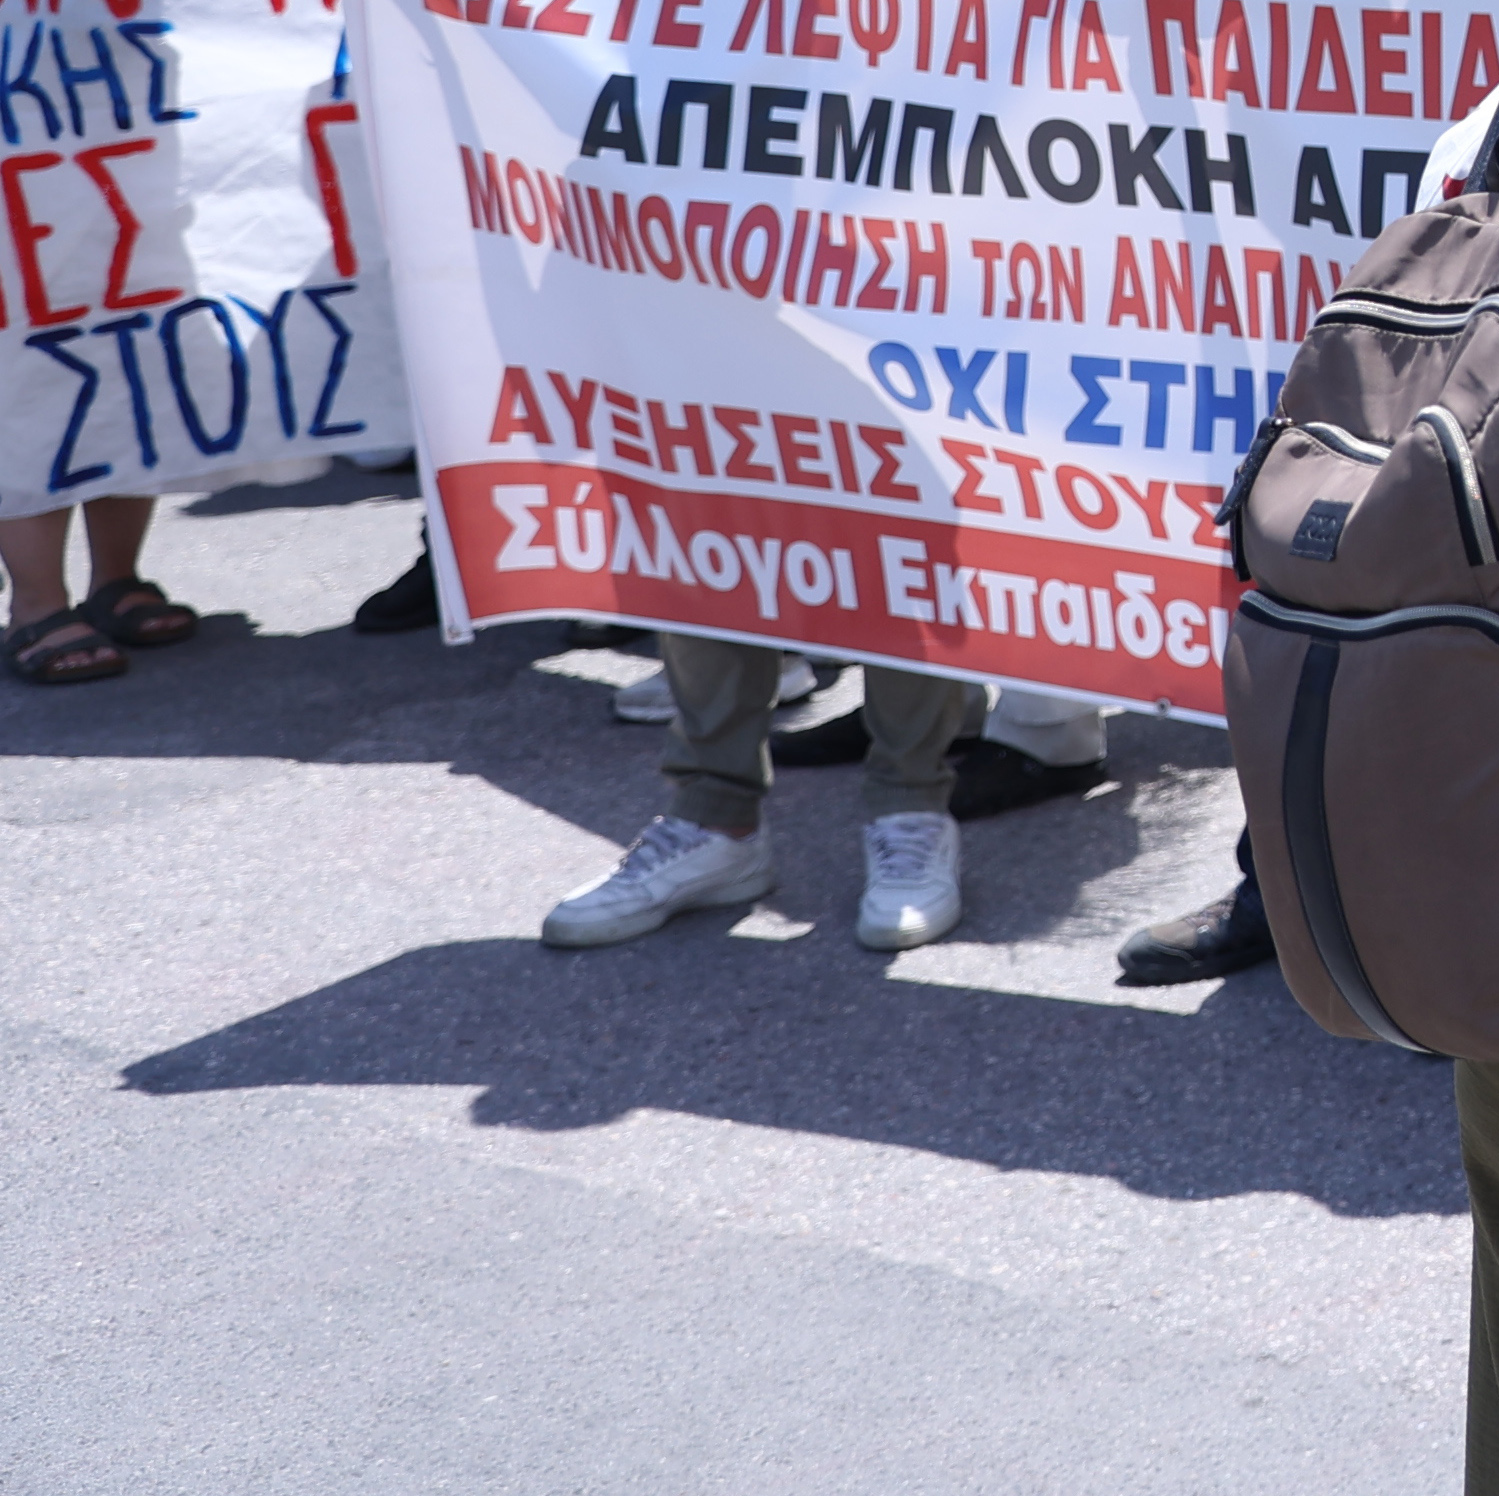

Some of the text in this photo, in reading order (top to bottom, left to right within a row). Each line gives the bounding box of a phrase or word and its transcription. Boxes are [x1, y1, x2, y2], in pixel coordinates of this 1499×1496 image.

[0, 137, 185, 329] ΕΣ
[459, 146, 949, 315] ΜΟΝΙΜΟΠΟΙΗΣΗ
[971, 240, 1084, 323] ΤΩΝ
[1109, 236, 1345, 342] ΑΝΑΠΛ
[580, 74, 1255, 217] ΑΠΕΜΠΛΟΚΗ
[1293, 145, 1430, 240] ΑΠ
[25, 282, 366, 494] ΣΤΟΥΣ
[489, 366, 920, 502] ΑΥΞΗΣΕΙΣ
[940, 438, 1230, 550] ΣΤΟΥΣ
[867, 341, 1027, 435] ΟΧΙ
[496, 481, 858, 620] Σύλλογοι
